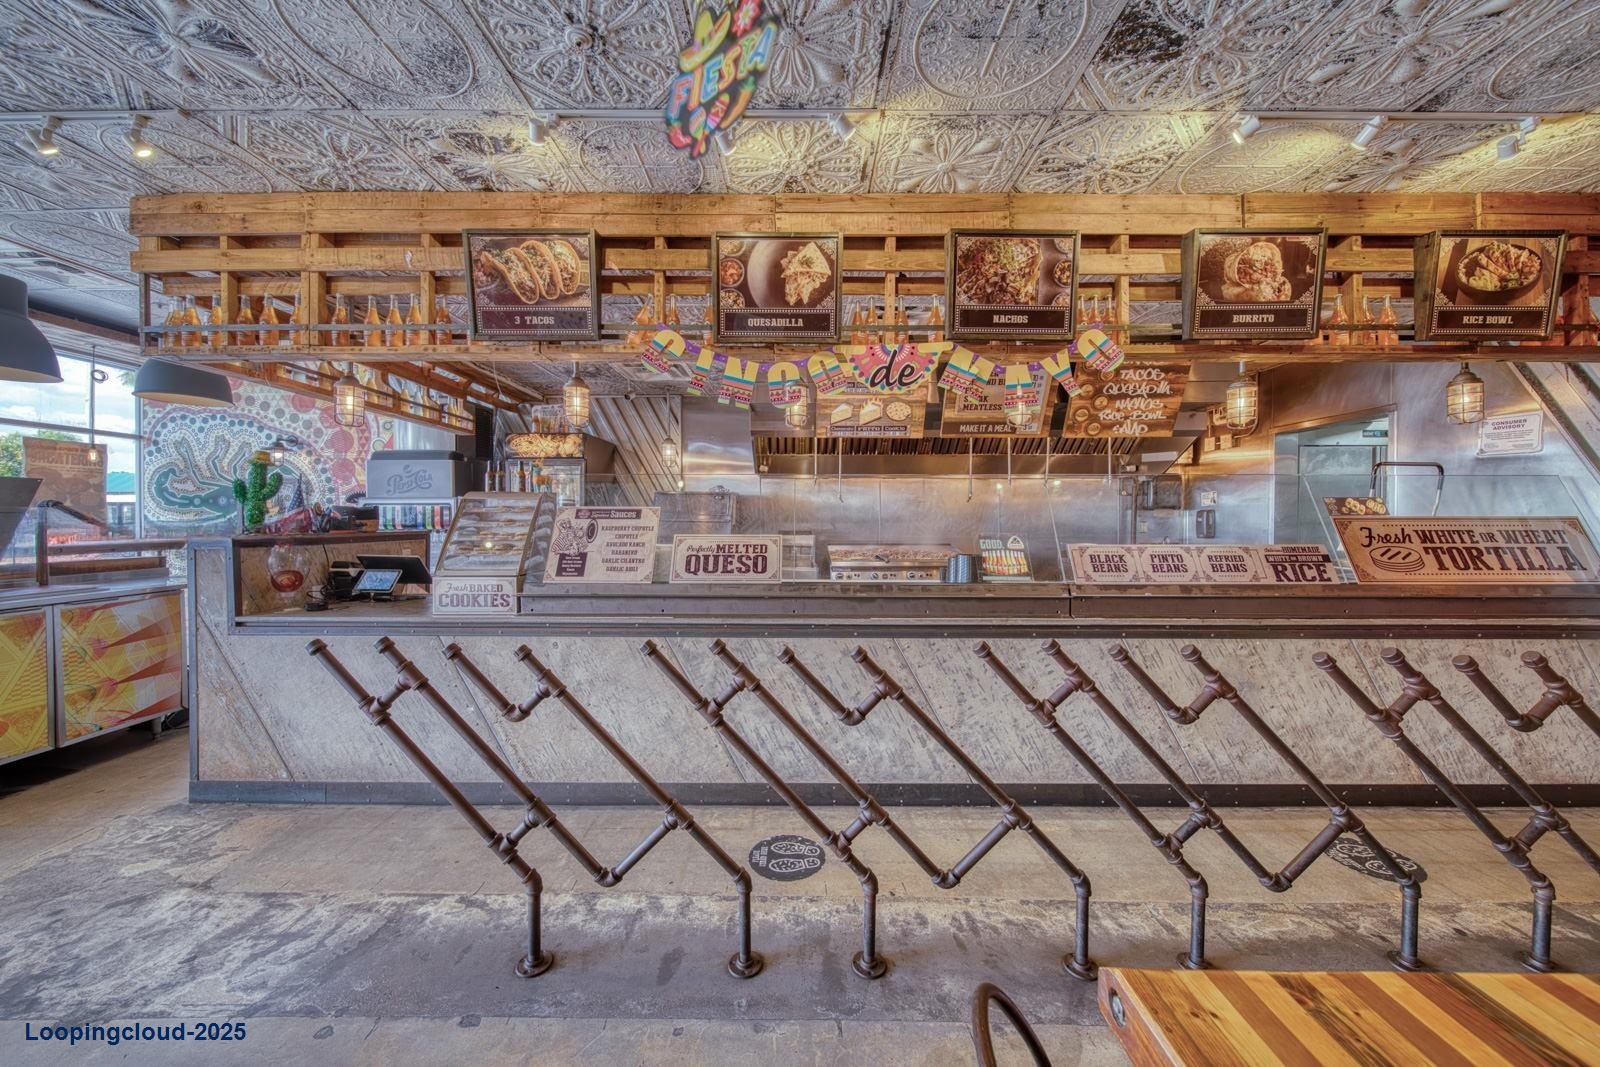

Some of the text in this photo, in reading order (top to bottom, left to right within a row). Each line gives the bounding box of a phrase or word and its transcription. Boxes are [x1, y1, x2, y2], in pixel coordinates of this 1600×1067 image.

[667, 20, 778, 120] FIESTA
[514, 316, 555, 326] 3 TACOS
[747, 318, 804, 327] QUESADILLA
[993, 315, 1029, 324] NACHOS
[1232, 314, 1275, 323] BURRITO
[1462, 316, 1514, 324] RICE BOWL
[871, 349, 925, 388] de
[1120, 368, 1166, 381] TACOS
[964, 395, 990, 403] SAK
[962, 404, 1003, 412] MEATLESS
[1114, 398, 1163, 411] NACHOS
[1129, 410, 1167, 420] BOWL
[1491, 418, 1528, 427] CONSUMER
[959, 424, 978, 433] MAKE
[979, 424, 986, 433] IT
[994, 424, 1012, 433] MEAL
[610, 510, 637, 519] Sauces
[1360, 527, 1568, 547] Fresh WHITE OR WHEAT
[716, 544, 768, 555] MELTED
[1089, 554, 1126, 564] BLACK
[1150, 554, 1184, 563] PINTO
[1207, 554, 1245, 563] REFRIED
[1424, 546, 1587, 571] TORTILLA
[685, 555, 769, 575] QUESO
[1090, 564, 1129, 573] BEANS
[1150, 564, 1189, 573] BEANS
[1210, 564, 1248, 573] BEANS
[1271, 564, 1332, 582] RICE
[469, 583, 504, 593] BAKED
[438, 593, 511, 608] COOKIES
